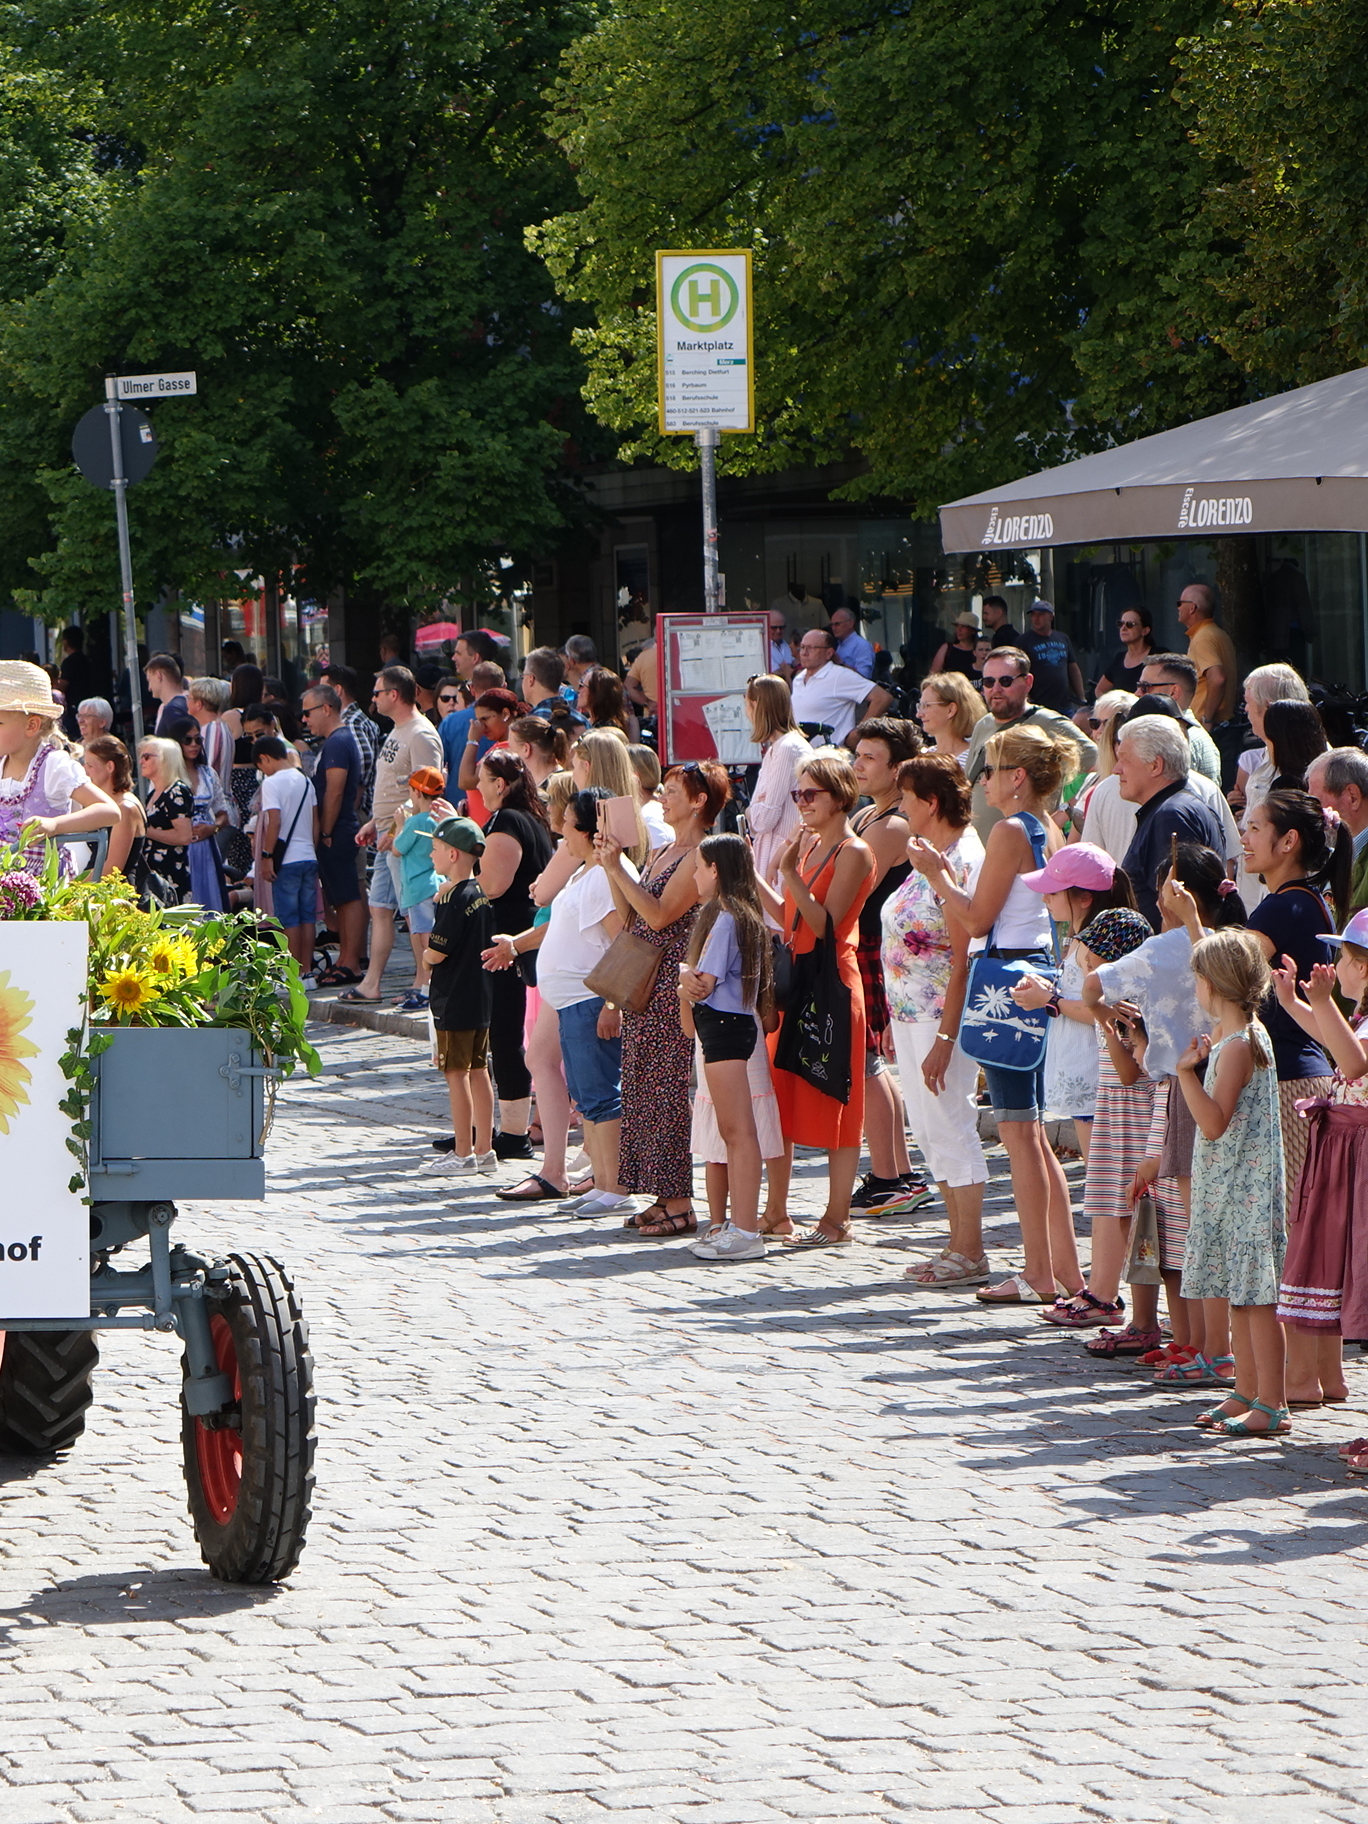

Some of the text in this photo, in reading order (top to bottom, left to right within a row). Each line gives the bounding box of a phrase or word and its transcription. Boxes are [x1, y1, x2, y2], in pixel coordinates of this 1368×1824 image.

[677, 341, 734, 352] Marktplatz
[123, 378, 191, 394] Ulmer Gasse
[1188, 497, 1253, 527] LORENZO
[993, 513, 1053, 544] LORENZO
